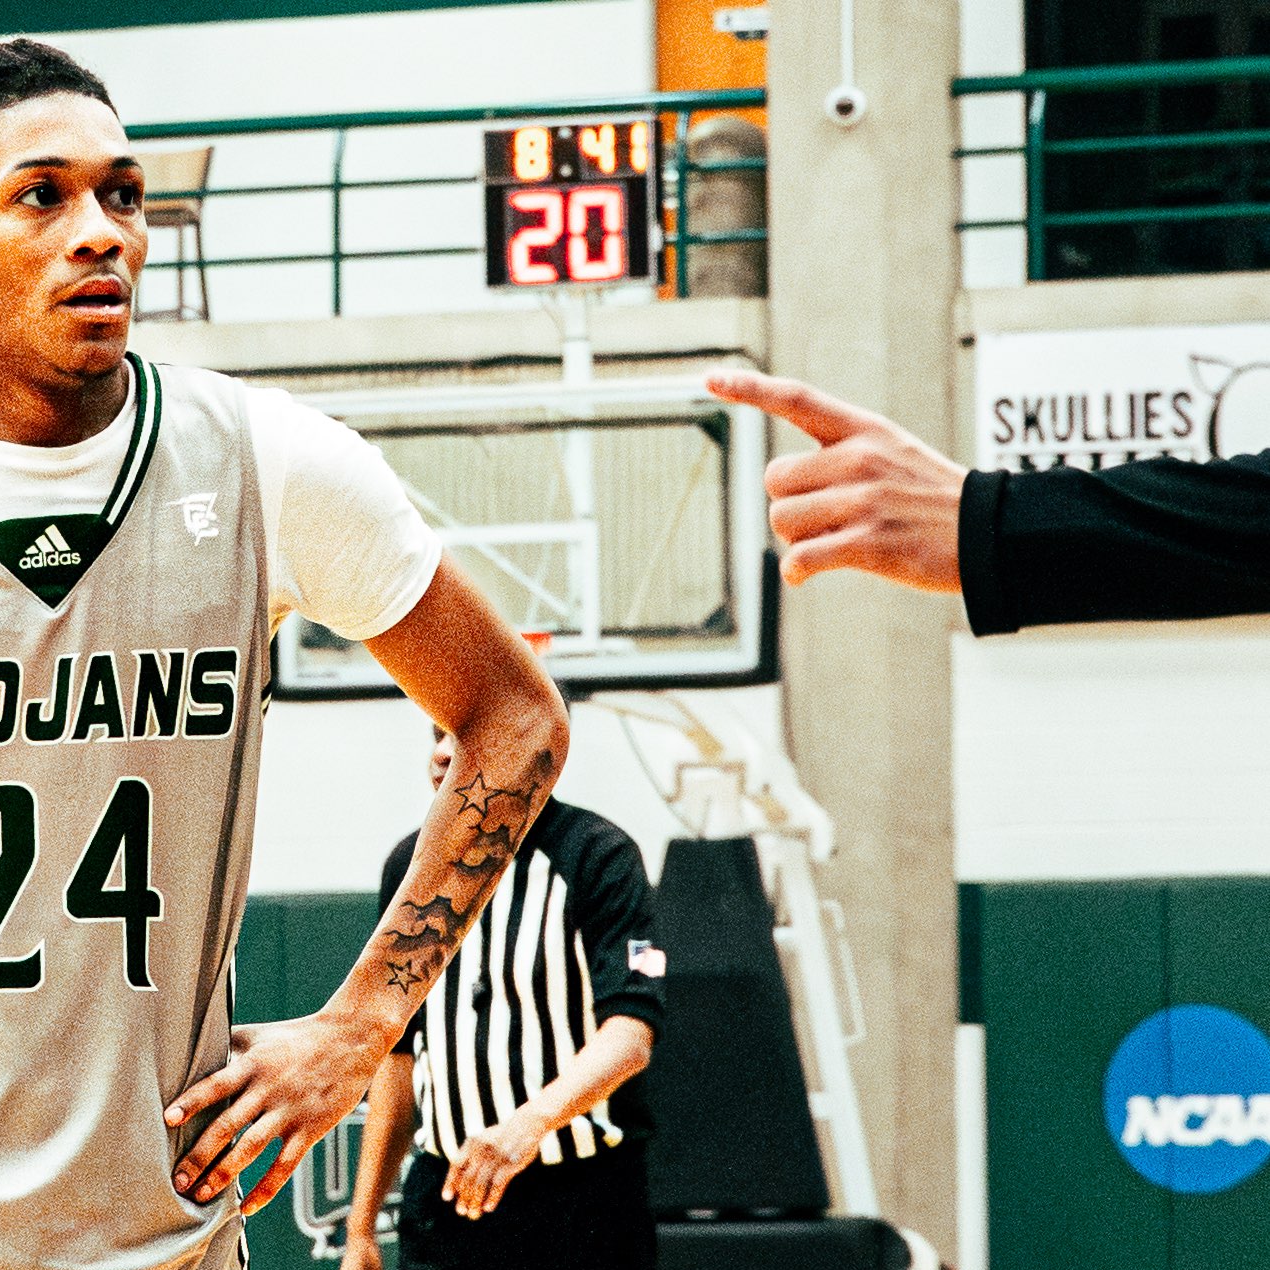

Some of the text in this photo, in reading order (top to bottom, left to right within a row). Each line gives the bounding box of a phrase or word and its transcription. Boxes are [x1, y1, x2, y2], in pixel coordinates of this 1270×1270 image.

[508, 185, 624, 285] 20
[994, 391, 1193, 444] SKULLIES
[19, 551, 82, 569] adidas
[1121, 1093, 1270, 1147] NCAA
